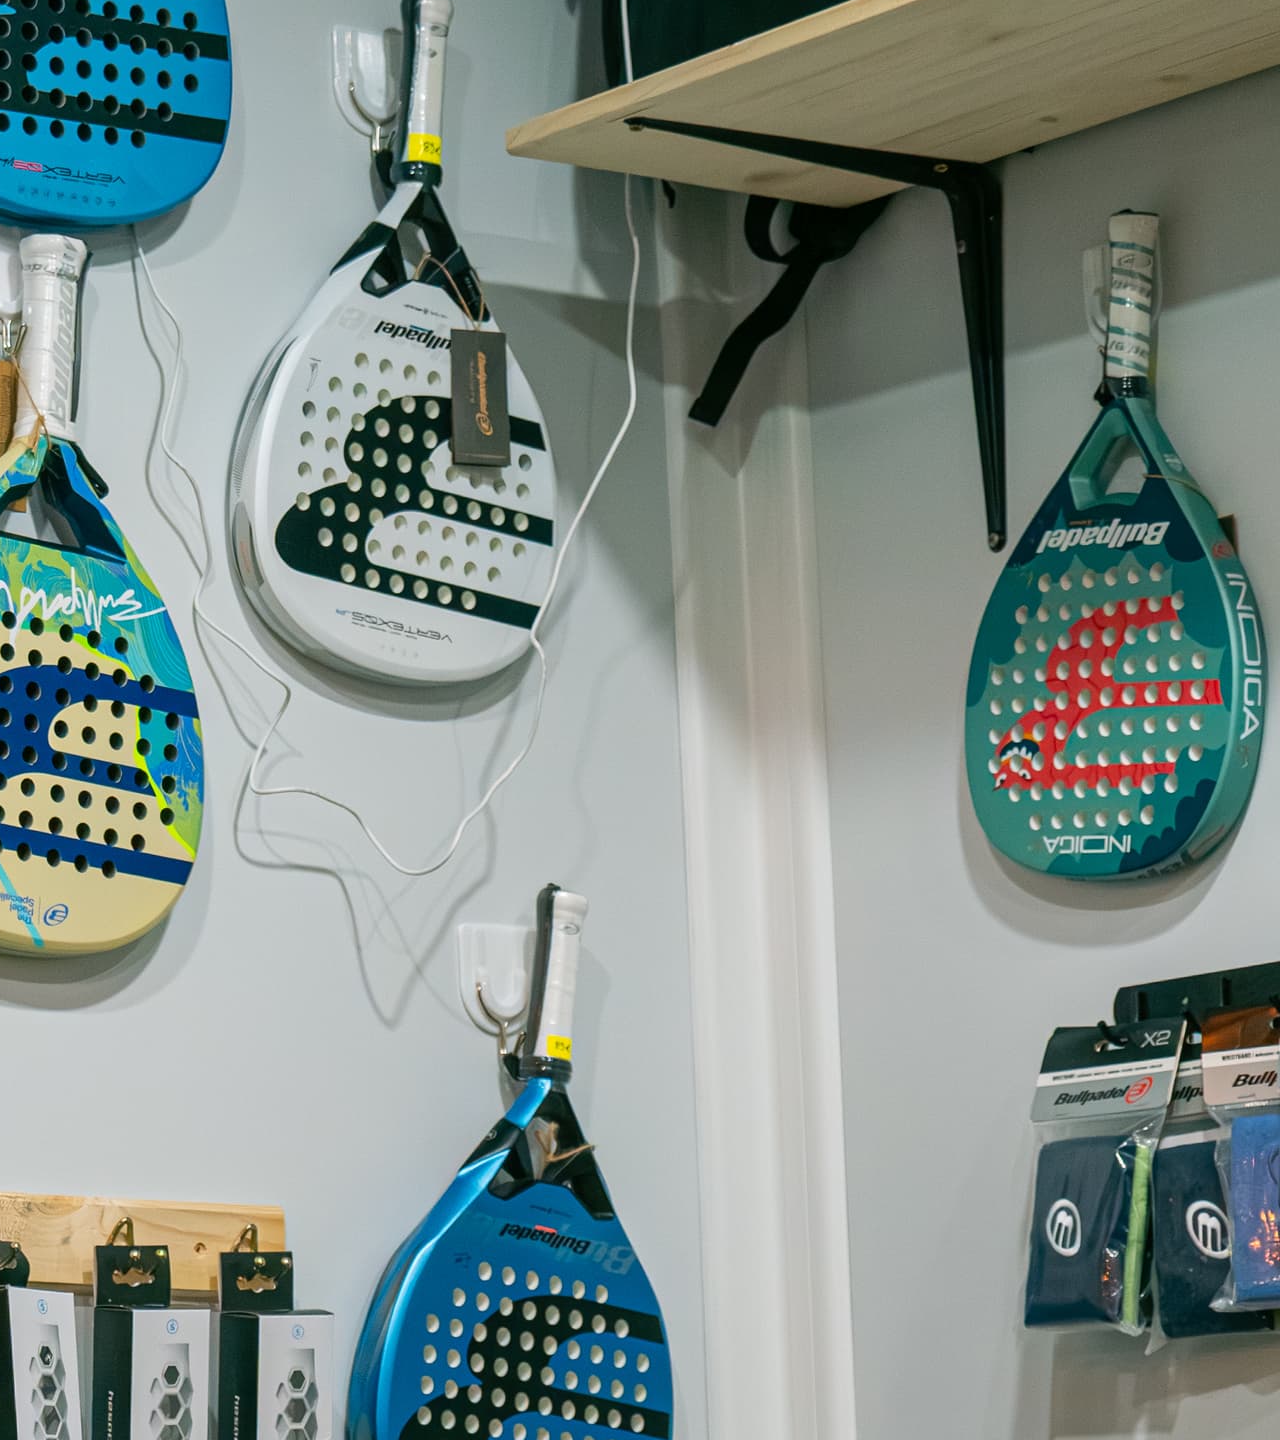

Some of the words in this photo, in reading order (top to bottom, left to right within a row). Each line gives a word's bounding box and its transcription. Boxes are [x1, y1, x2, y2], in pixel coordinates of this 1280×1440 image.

[374, 320, 452, 351] ullpadel
[1035, 518, 1171, 554] Bullpadel
[1224, 571, 1263, 740] INDIGA
[1041, 834, 1132, 854] INDIGA
[1139, 1029, 1172, 1049] X2
[1054, 1083, 1129, 1107] Bullpadel
[498, 1223, 592, 1255] Bullpadel
